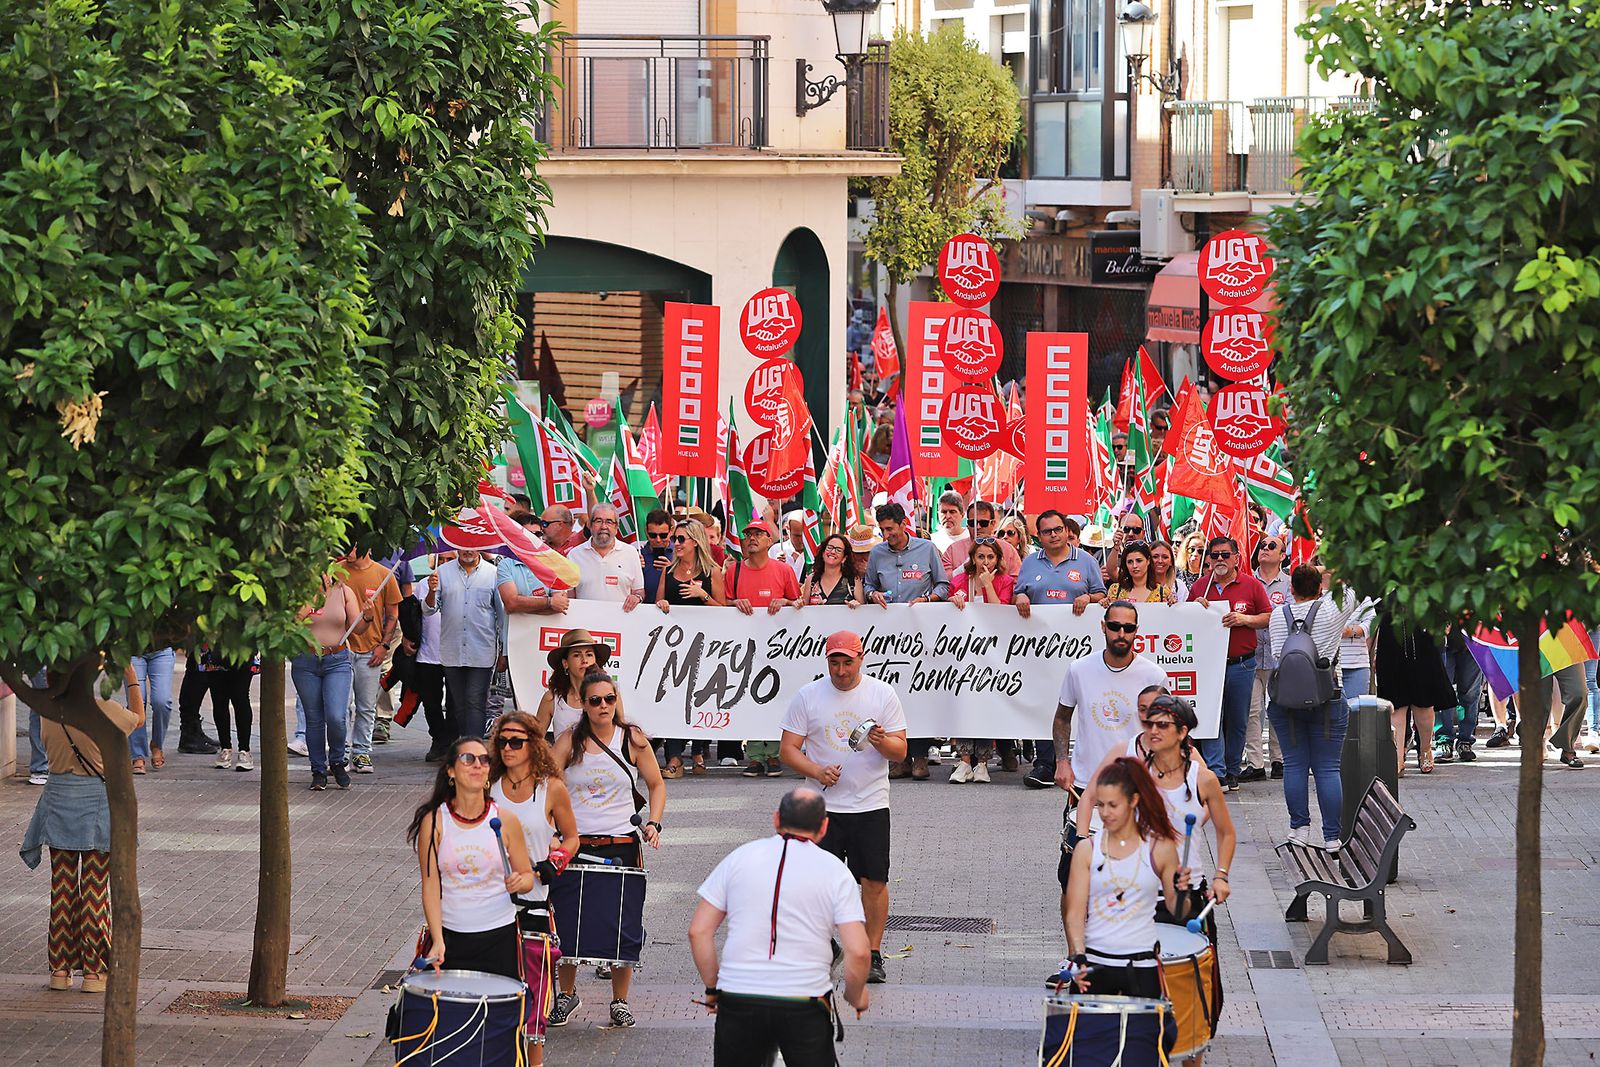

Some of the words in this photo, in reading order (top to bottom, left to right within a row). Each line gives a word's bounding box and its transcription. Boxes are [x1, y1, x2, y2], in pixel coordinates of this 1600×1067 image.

[948, 241, 989, 268] UGT
[1208, 237, 1262, 267] UGT
[954, 289, 986, 300] Andalucía
[1217, 285, 1257, 298] Andalucía
[748, 293, 790, 326] UGT
[1148, 311, 1180, 328] manuela
[1211, 313, 1263, 341] UGT
[947, 316, 992, 343] UGT
[755, 338, 788, 352] Andalucía
[954, 364, 988, 376] Andalucía
[1220, 362, 1260, 374] Andalucía
[949, 393, 995, 417] UGT
[1217, 391, 1266, 418] UGT
[677, 449, 699, 458] HUELVA
[955, 439, 991, 451] Andalucía
[1189, 426, 1215, 467] UGT
[1225, 439, 1263, 450] Andalucía
[761, 480, 798, 491] Andalucía
[902, 571, 915, 579] UGT
[706, 639, 732, 657] DE
[933, 624, 998, 662] bajar
[1005, 632, 1093, 664] precios
[1132, 635, 1160, 653] GT
[1156, 654, 1194, 665] Huelva
[909, 660, 1023, 697] beneficios
[693, 711, 731, 730] 2023
